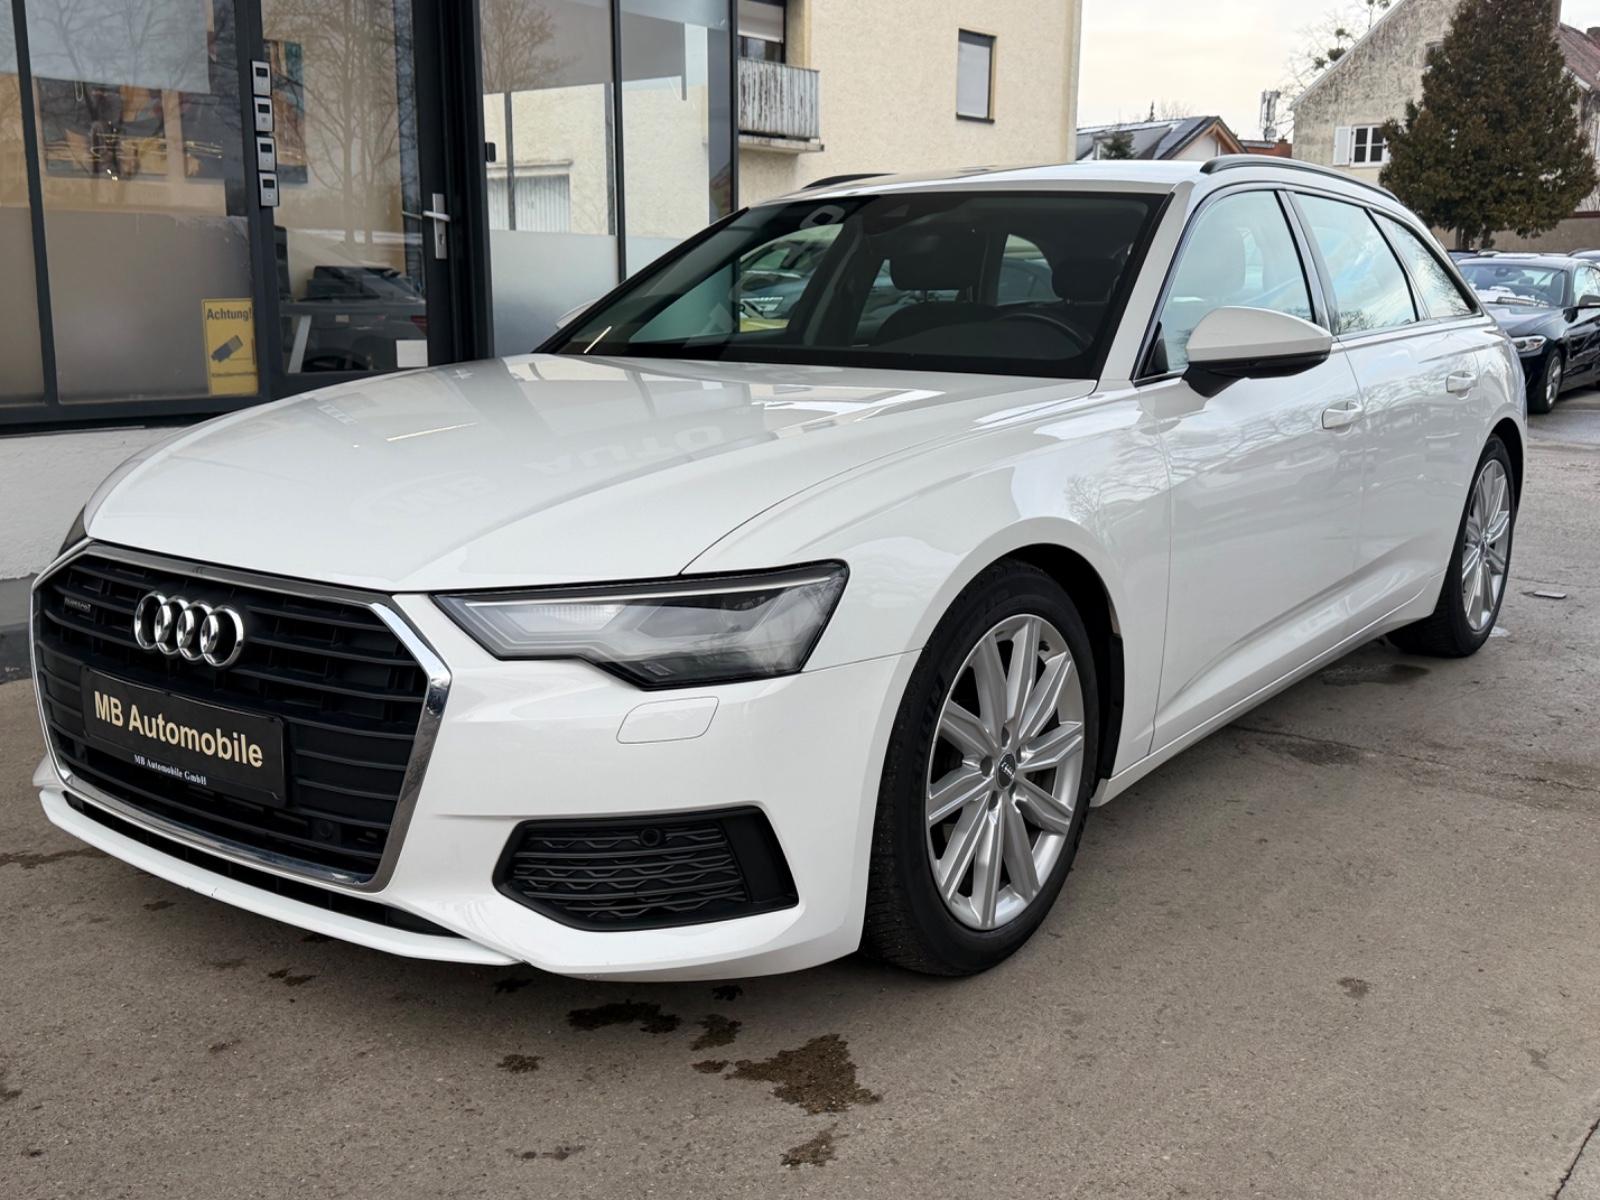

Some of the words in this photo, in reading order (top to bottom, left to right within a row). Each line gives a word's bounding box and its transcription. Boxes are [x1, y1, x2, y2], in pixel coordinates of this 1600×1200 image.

[207, 308, 252, 321] Achtung!
[94, 691, 124, 727] MB
[129, 705, 262, 767] Automobile
[134, 754, 146, 767] MB
[146, 758, 183, 778] Automobile
[184, 770, 207, 785] GmbH
